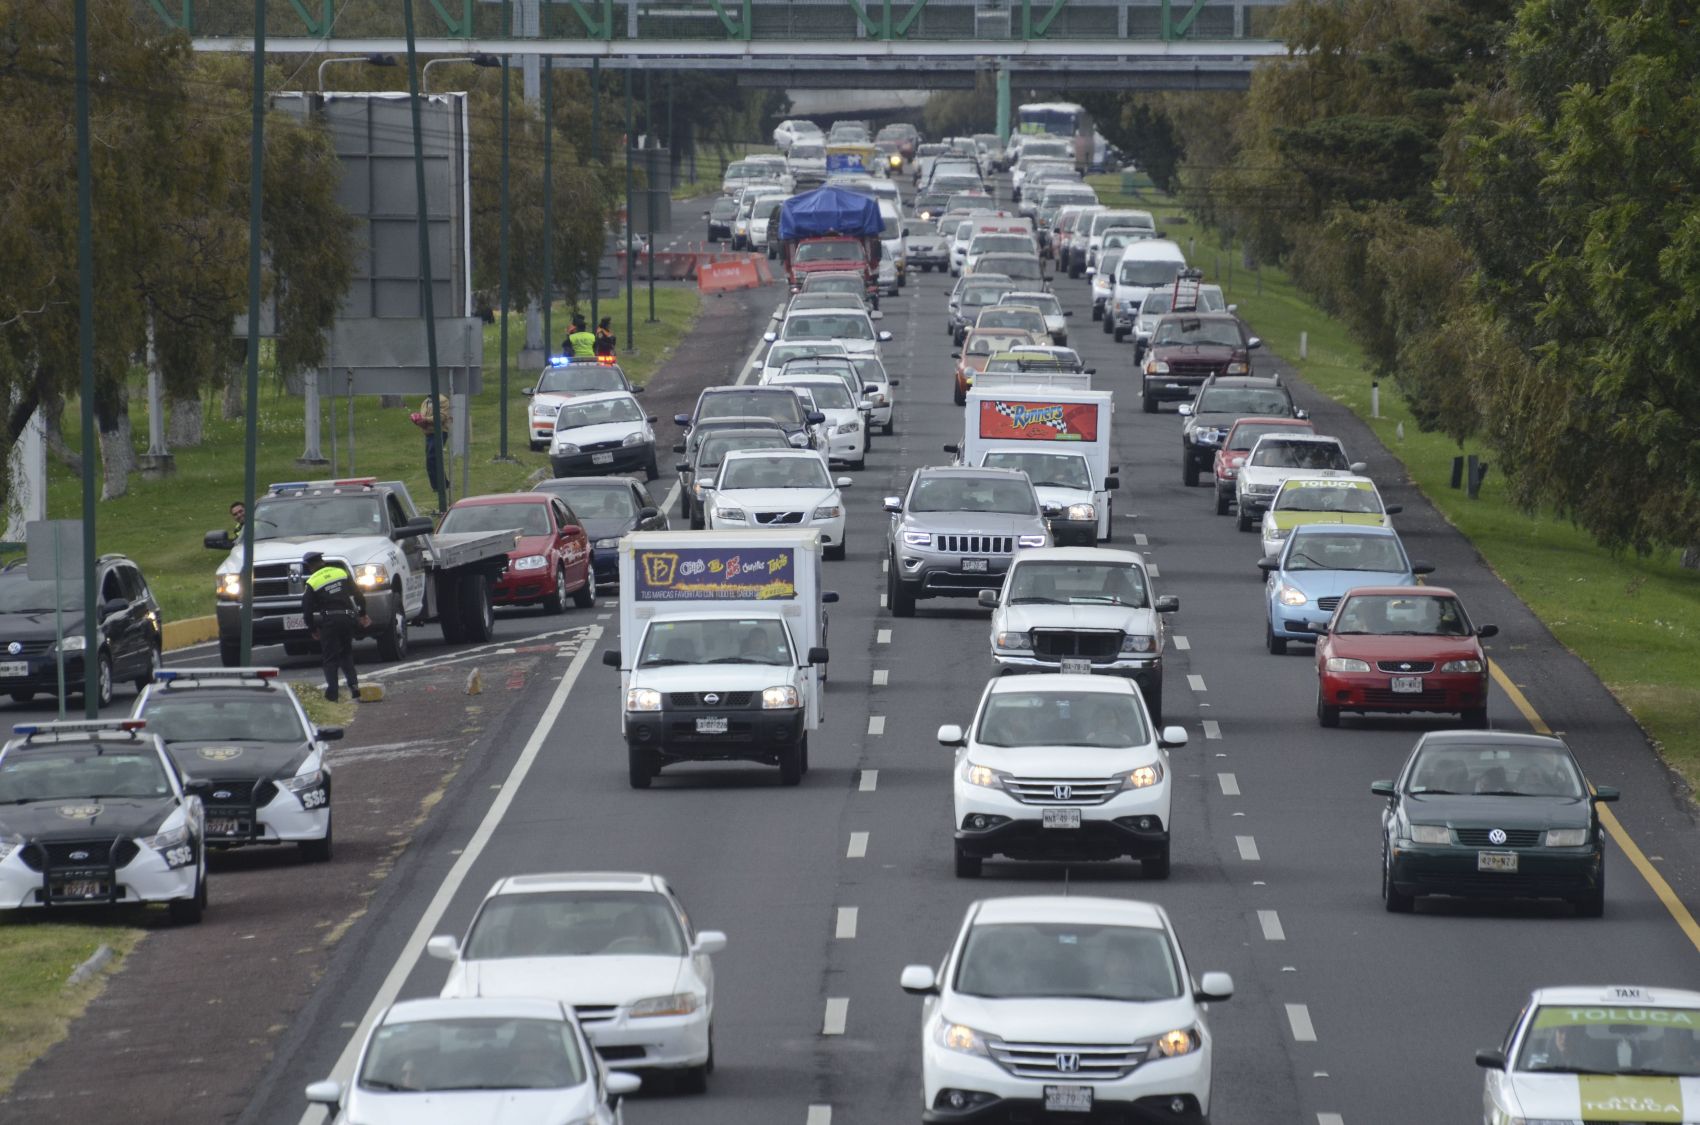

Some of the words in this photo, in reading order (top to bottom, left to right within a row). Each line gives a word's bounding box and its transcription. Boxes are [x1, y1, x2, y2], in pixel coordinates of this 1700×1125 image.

[1010, 404, 1064, 430] Runners
[1300, 480, 1358, 489] TOLUCA
[652, 590, 674, 599] MARCAS
[303, 789, 326, 808] SSC
[166, 846, 192, 867] SSC
[1615, 988, 1640, 998] TAXI
[1566, 1008, 1694, 1025] TOLUCA
[1585, 1100, 1681, 1113] TOLUCA
